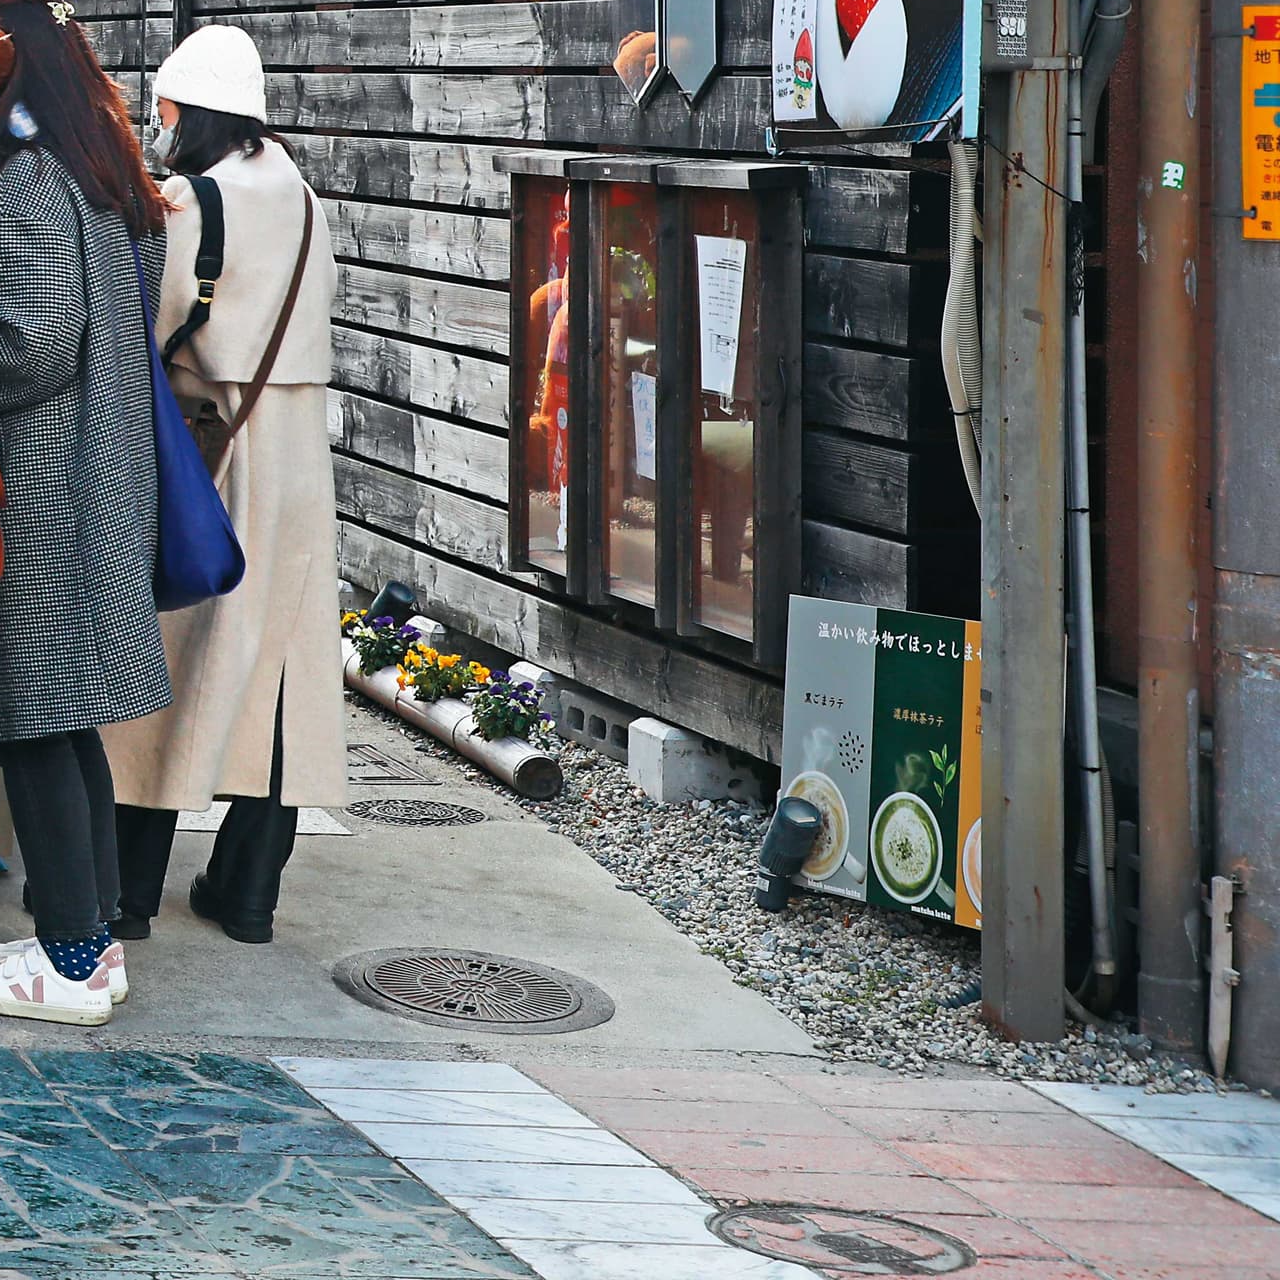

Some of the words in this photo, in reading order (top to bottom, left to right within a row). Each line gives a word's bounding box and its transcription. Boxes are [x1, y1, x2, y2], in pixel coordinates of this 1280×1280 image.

[804, 692, 844, 709] 黒ごまラテ
[893, 708, 944, 727] 濃厚抹茶ラテ
